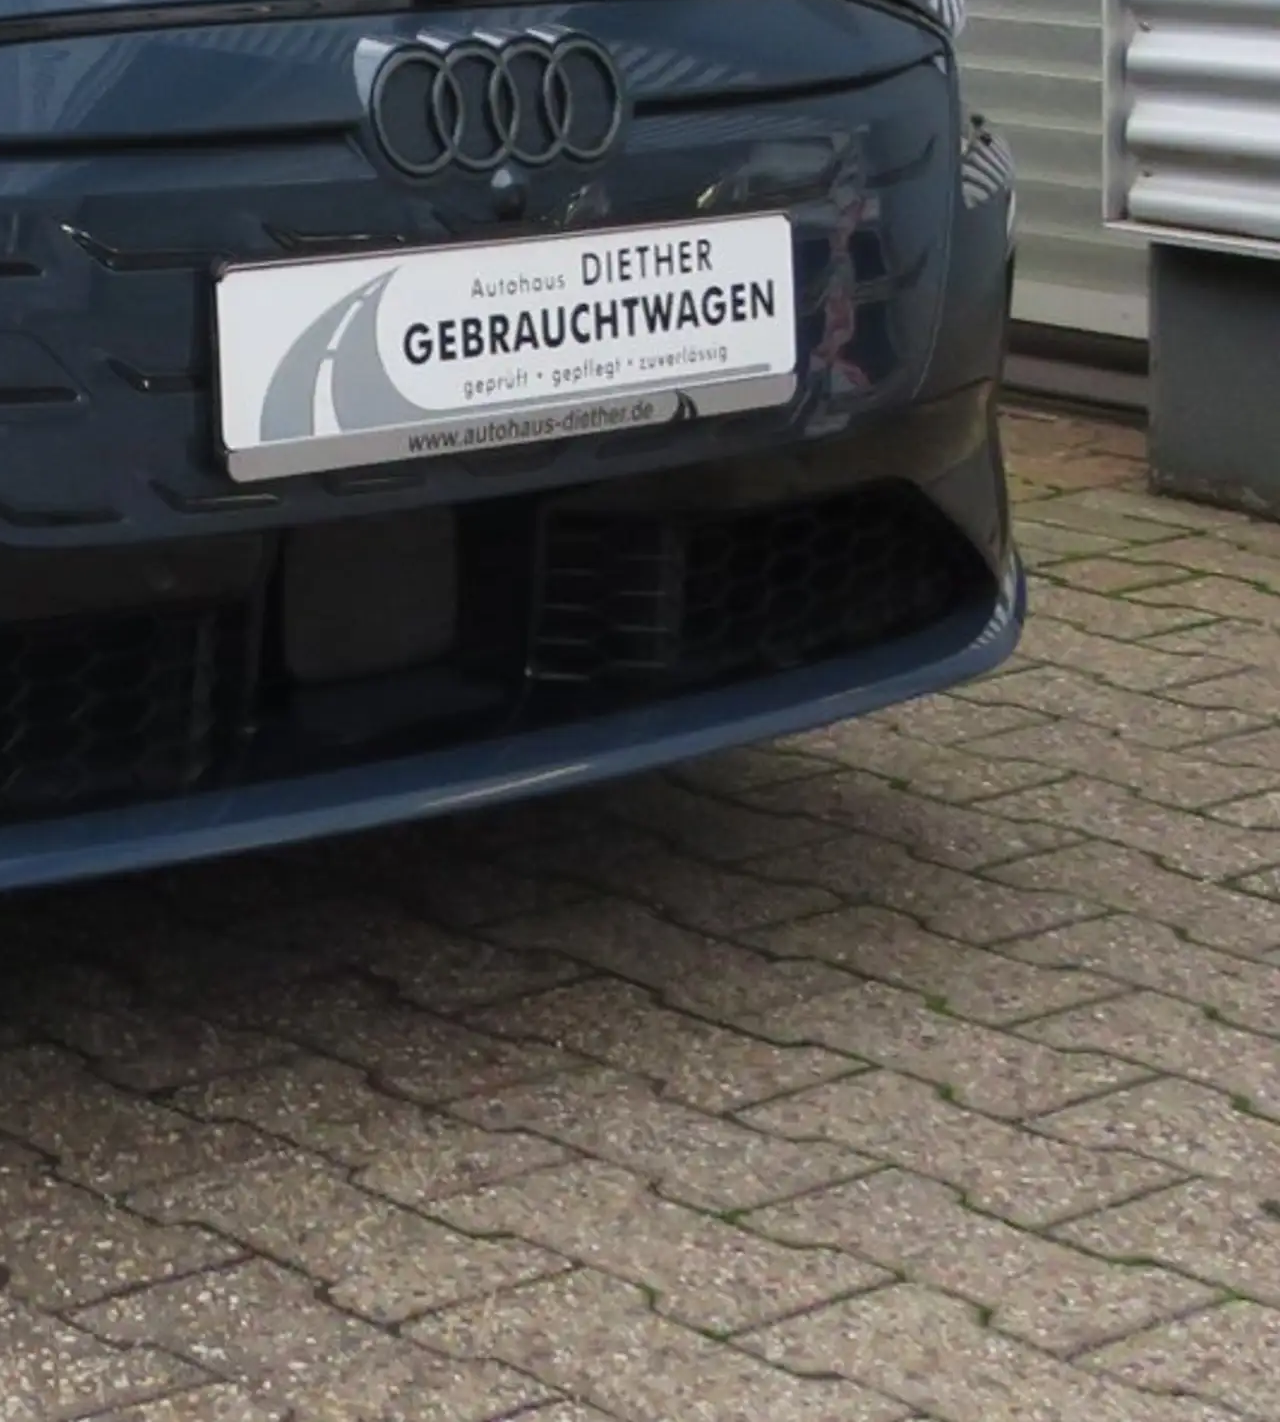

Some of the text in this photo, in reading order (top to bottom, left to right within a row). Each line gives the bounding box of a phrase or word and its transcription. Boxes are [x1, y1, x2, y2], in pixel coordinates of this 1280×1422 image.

[470, 238, 714, 299] Autohaus DIETHER
[403, 278, 777, 366] GEBRAUCHTWAGEN
[551, 357, 621, 388] gepflegt
[407, 400, 654, 454] www.autohaus-diether.de
